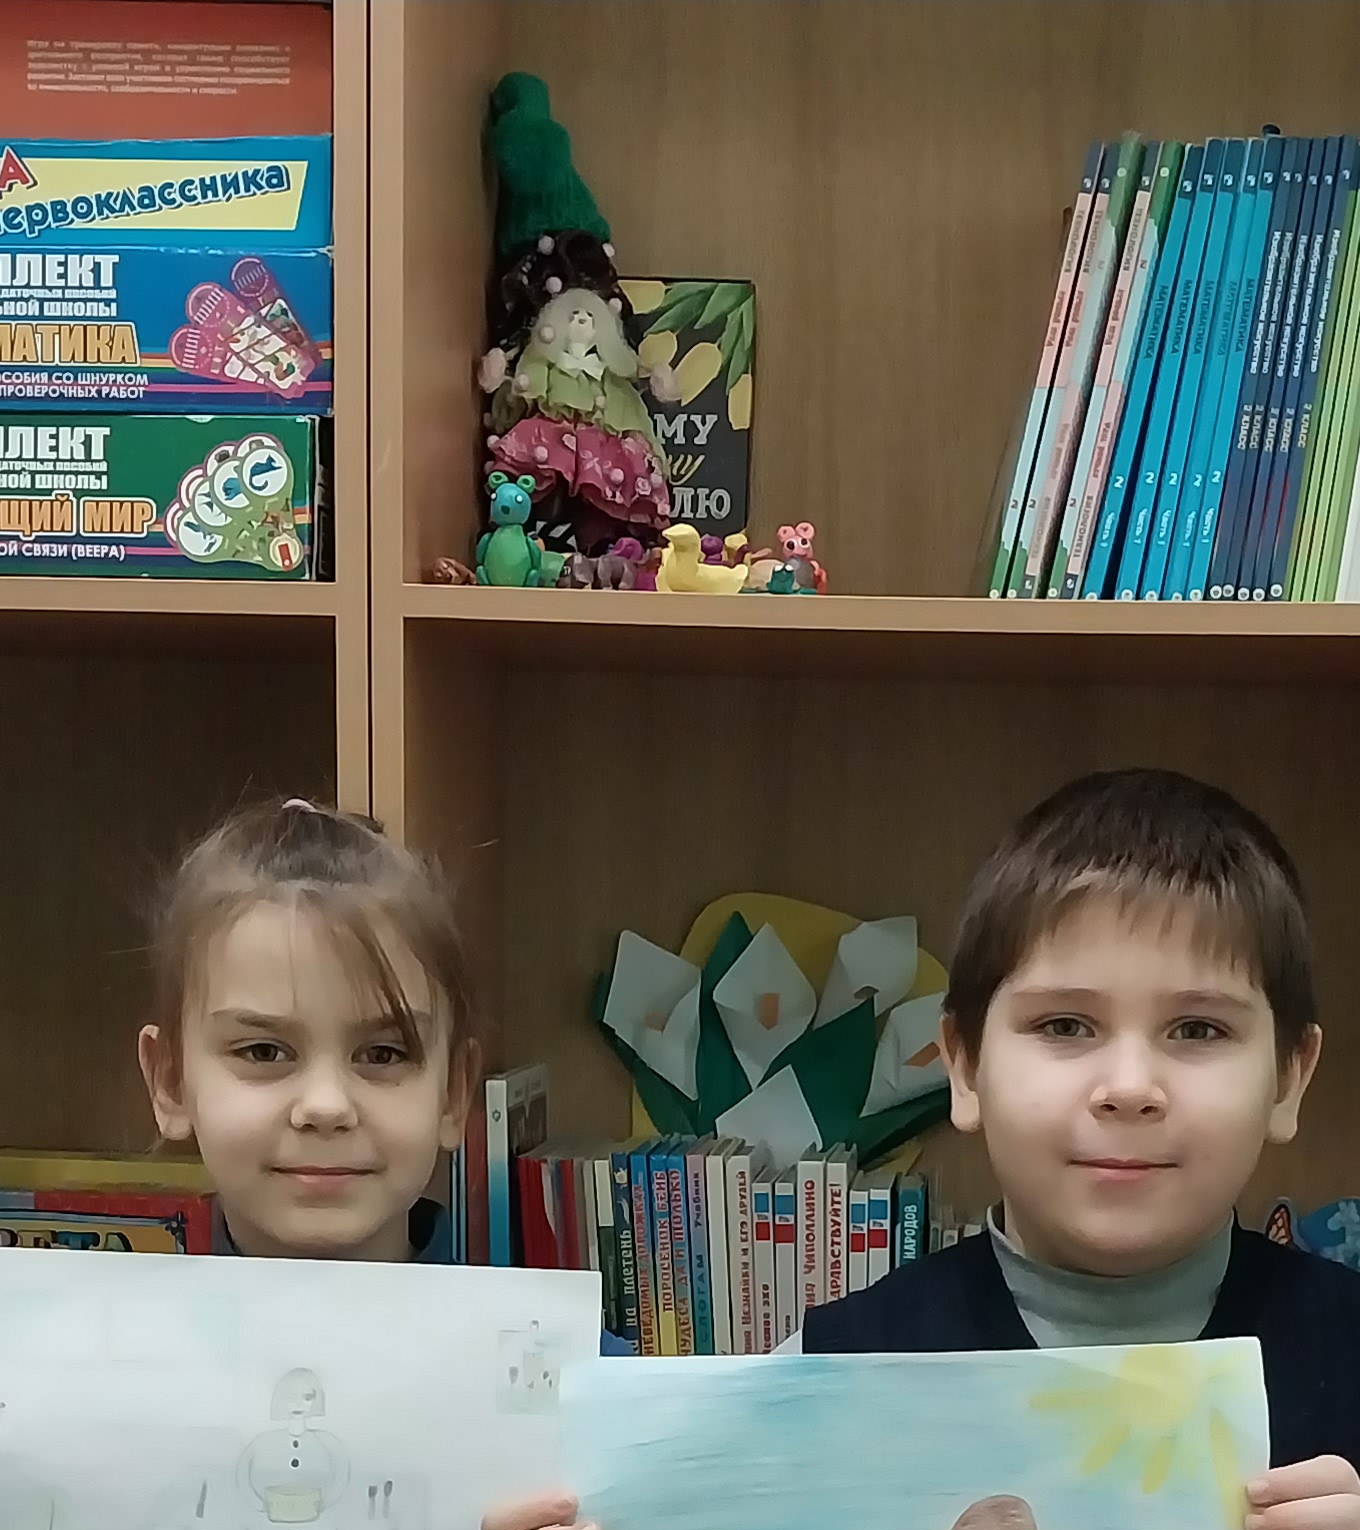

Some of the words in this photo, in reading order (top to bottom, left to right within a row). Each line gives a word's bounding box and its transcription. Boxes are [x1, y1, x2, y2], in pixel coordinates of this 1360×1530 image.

[42, 301, 118, 318] ШКОЛЫ
[1142, 284, 1170, 360] МАТЕМАТИКА
[1169, 279, 1195, 355] МАТЕМАТИКА
[1191, 280, 1217, 355] МАТЕМАТИКА
[1216, 281, 1239, 357] МАТЕМАТИКА
[1233, 278, 1257, 354] МАТЕМАТИКА
[51, 371, 74, 385] СО
[77, 372, 149, 387] ШНУРКОМ
[101, 386, 146, 401] РАБОТ
[653, 413, 719, 446] МУ
[1236, 415, 1251, 450] КЛАСС
[1248, 415, 1263, 450] КЛАСС
[1264, 418, 1279, 453] КЛАСС
[1279, 418, 1294, 453] КЛАСС
[1296, 413, 1311, 449] КЛАСС
[34, 473, 109, 491] ШКОЛЫ
[1113, 475, 1126, 489] 2
[1144, 471, 1156, 485] 2
[1168, 472, 1179, 486] 2
[1192, 473, 1204, 488] 2
[1210, 470, 1222, 484] 2
[80, 497, 157, 538] МИР
[668, 487, 732, 520] ЛЮ
[21, 543, 69, 559] СВЯЗИ
[70, 544, 126, 562] (ВЕЕРА)
[828, 1183, 843, 1299] ДРАВСТВУЙТЕ!
[903, 1204, 919, 1260] НАРОДОВ
[619, 1229, 637, 1296] плетень
[674, 1265, 689, 1287] ДА
[639, 1269, 655, 1355] НЕВЕДОМЫХ
